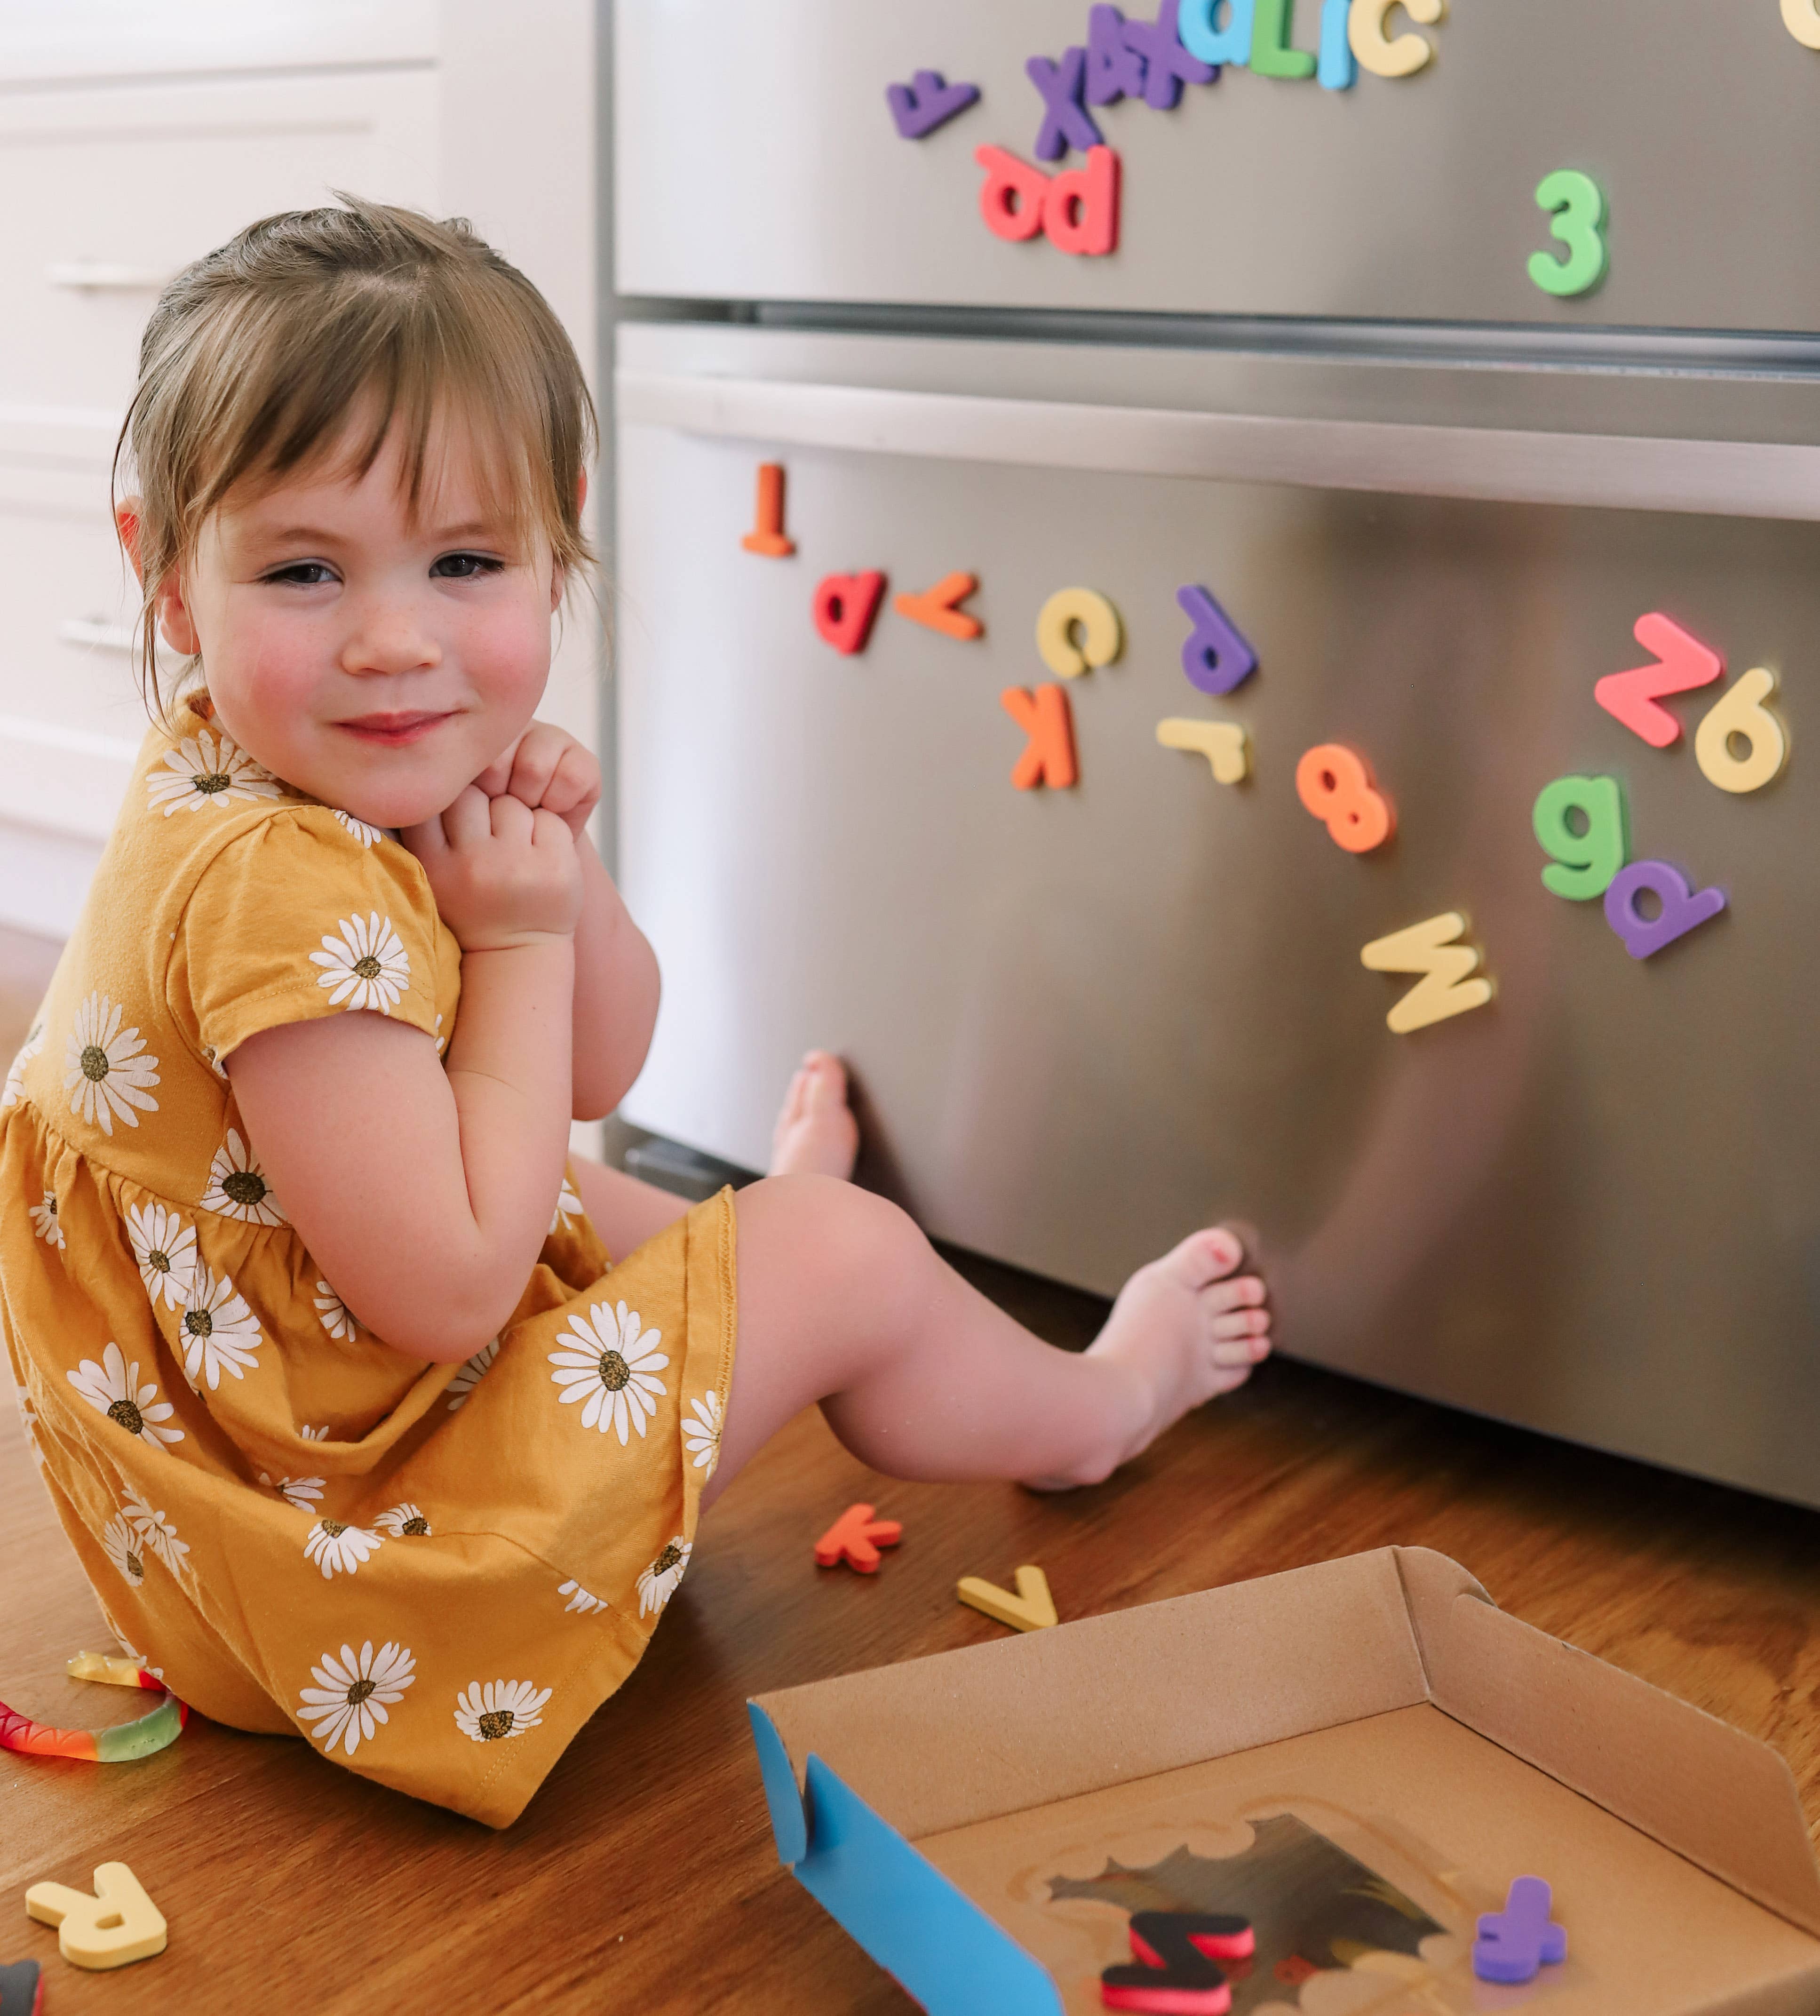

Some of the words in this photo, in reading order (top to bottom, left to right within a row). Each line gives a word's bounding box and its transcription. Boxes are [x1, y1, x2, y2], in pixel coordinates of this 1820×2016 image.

[1527, 168, 1609, 297] 3
[1695, 668, 1787, 793] 6
[1295, 743, 1393, 853] 8
[25, 1862, 167, 1970] R
